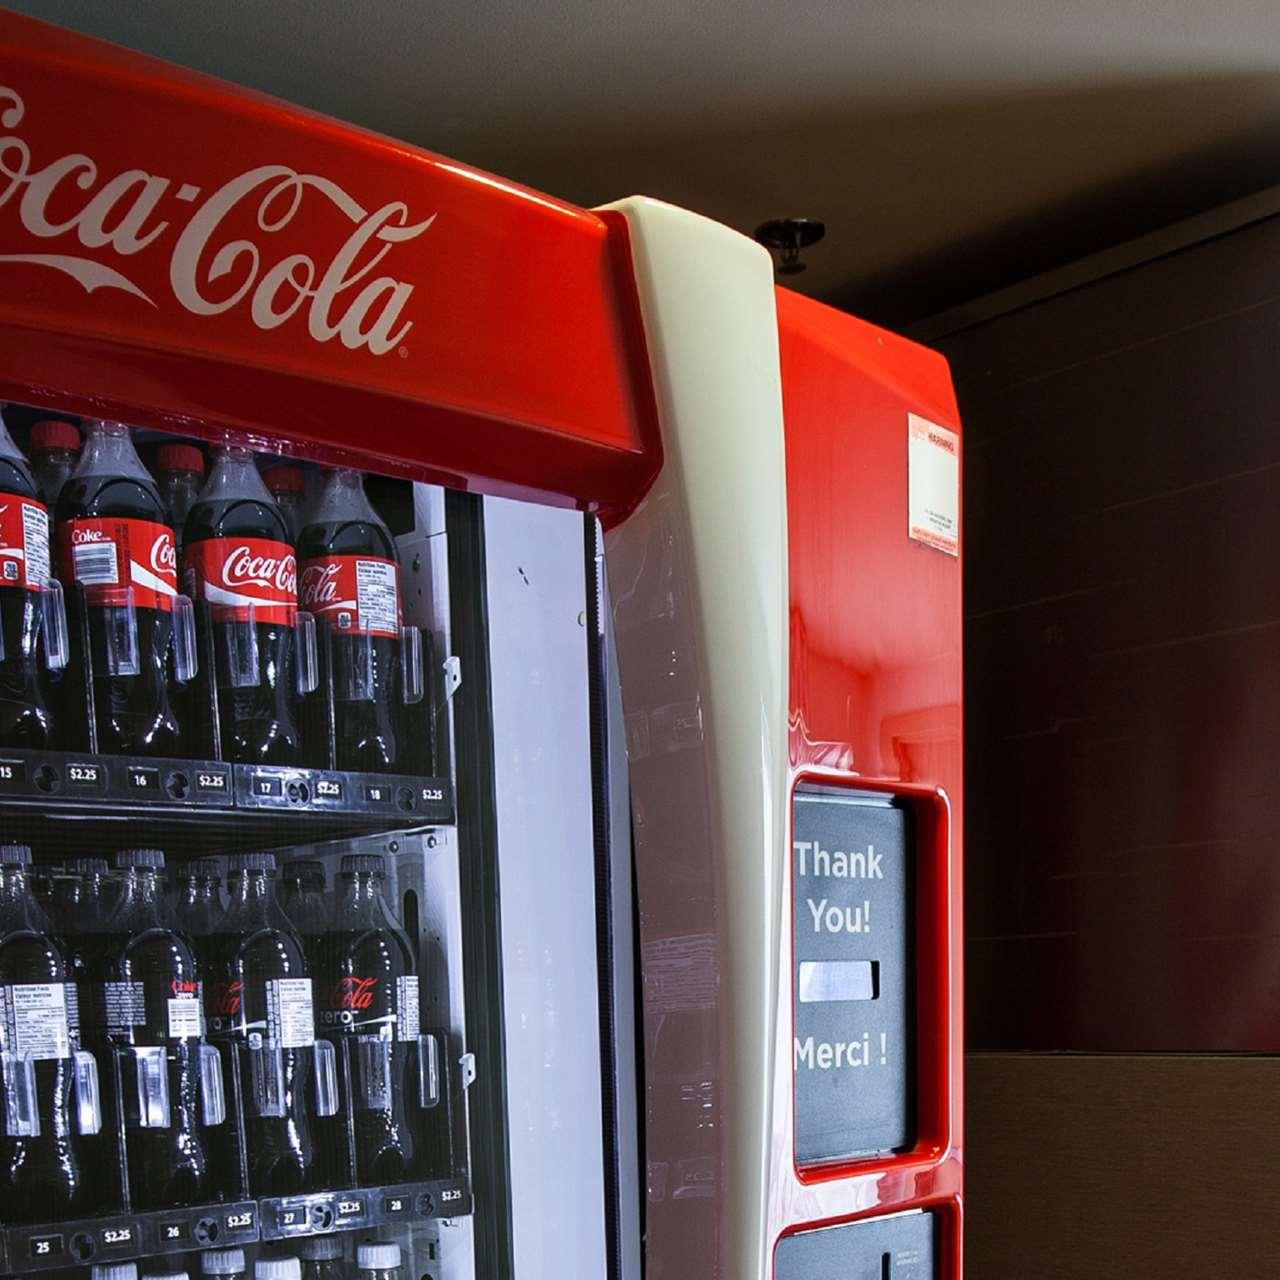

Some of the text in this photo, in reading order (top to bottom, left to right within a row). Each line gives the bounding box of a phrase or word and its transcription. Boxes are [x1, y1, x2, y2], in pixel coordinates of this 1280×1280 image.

[72, 528, 102, 544] Coke
[0, 767, 12, 780] 15
[70, 768, 97, 781] $2.25
[134, 775, 146, 786] 16
[199, 774, 224, 788] $2.25
[260, 781, 271, 793] 17
[317, 782, 340, 795] $2.25
[370, 789, 380, 800] 18
[422, 789, 443, 800] $2.25
[793, 841, 884, 880] Thank
[807, 899, 870, 933] You!
[793, 1033, 869, 1071] Merci
[441, 1189, 463, 1201] $2.25
[338, 1202, 361, 1215] $2.25
[391, 1200, 402, 1211] 28
[227, 1214, 252, 1228] $2.25
[282, 1212, 295, 1224] 27
[104, 1229, 131, 1243] $2.25
[166, 1227, 180, 1238] 26
[36, 1242, 50, 1254] 25
